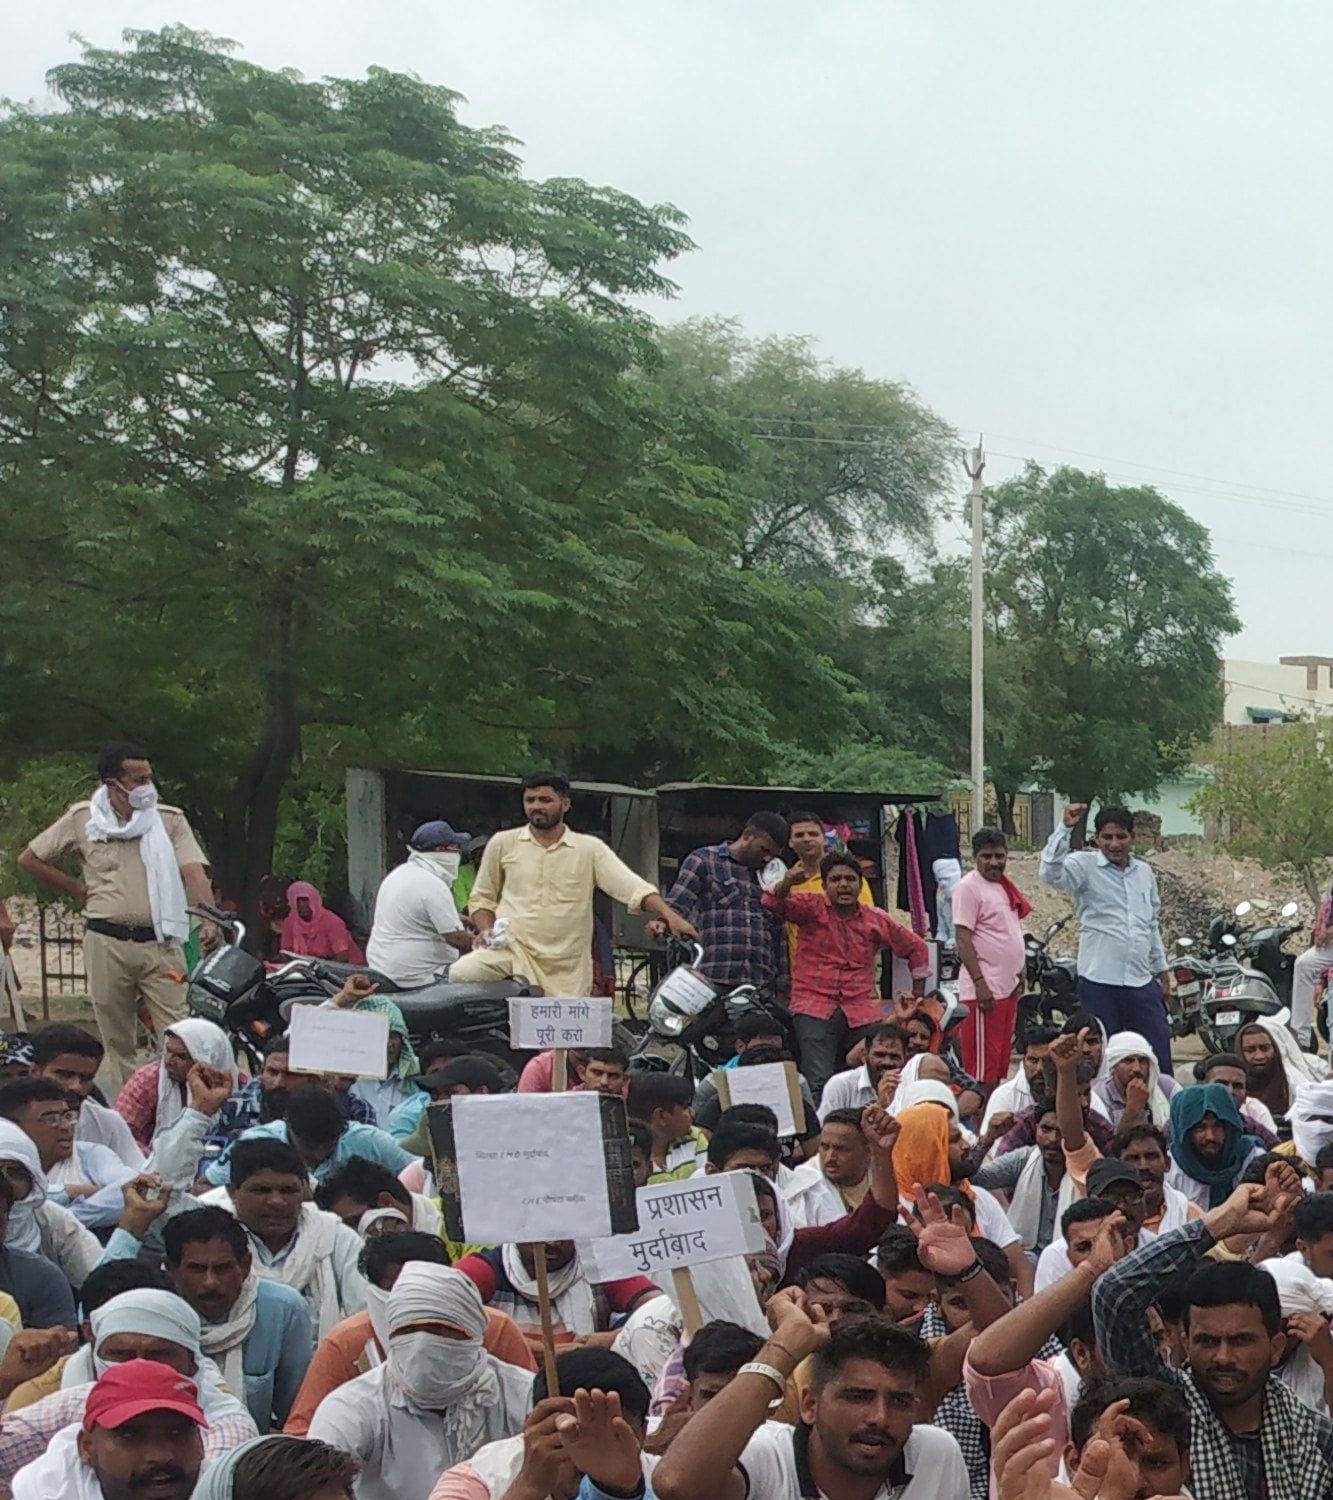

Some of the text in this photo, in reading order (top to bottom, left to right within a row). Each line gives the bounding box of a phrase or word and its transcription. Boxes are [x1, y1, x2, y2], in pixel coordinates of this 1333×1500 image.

[531, 1001, 590, 1019] हमारी मांगे
[536, 1024, 583, 1046] पूरी करो
[645, 1186, 723, 1220] प्रशासन
[629, 1229, 707, 1271] मुर्दाबाद
